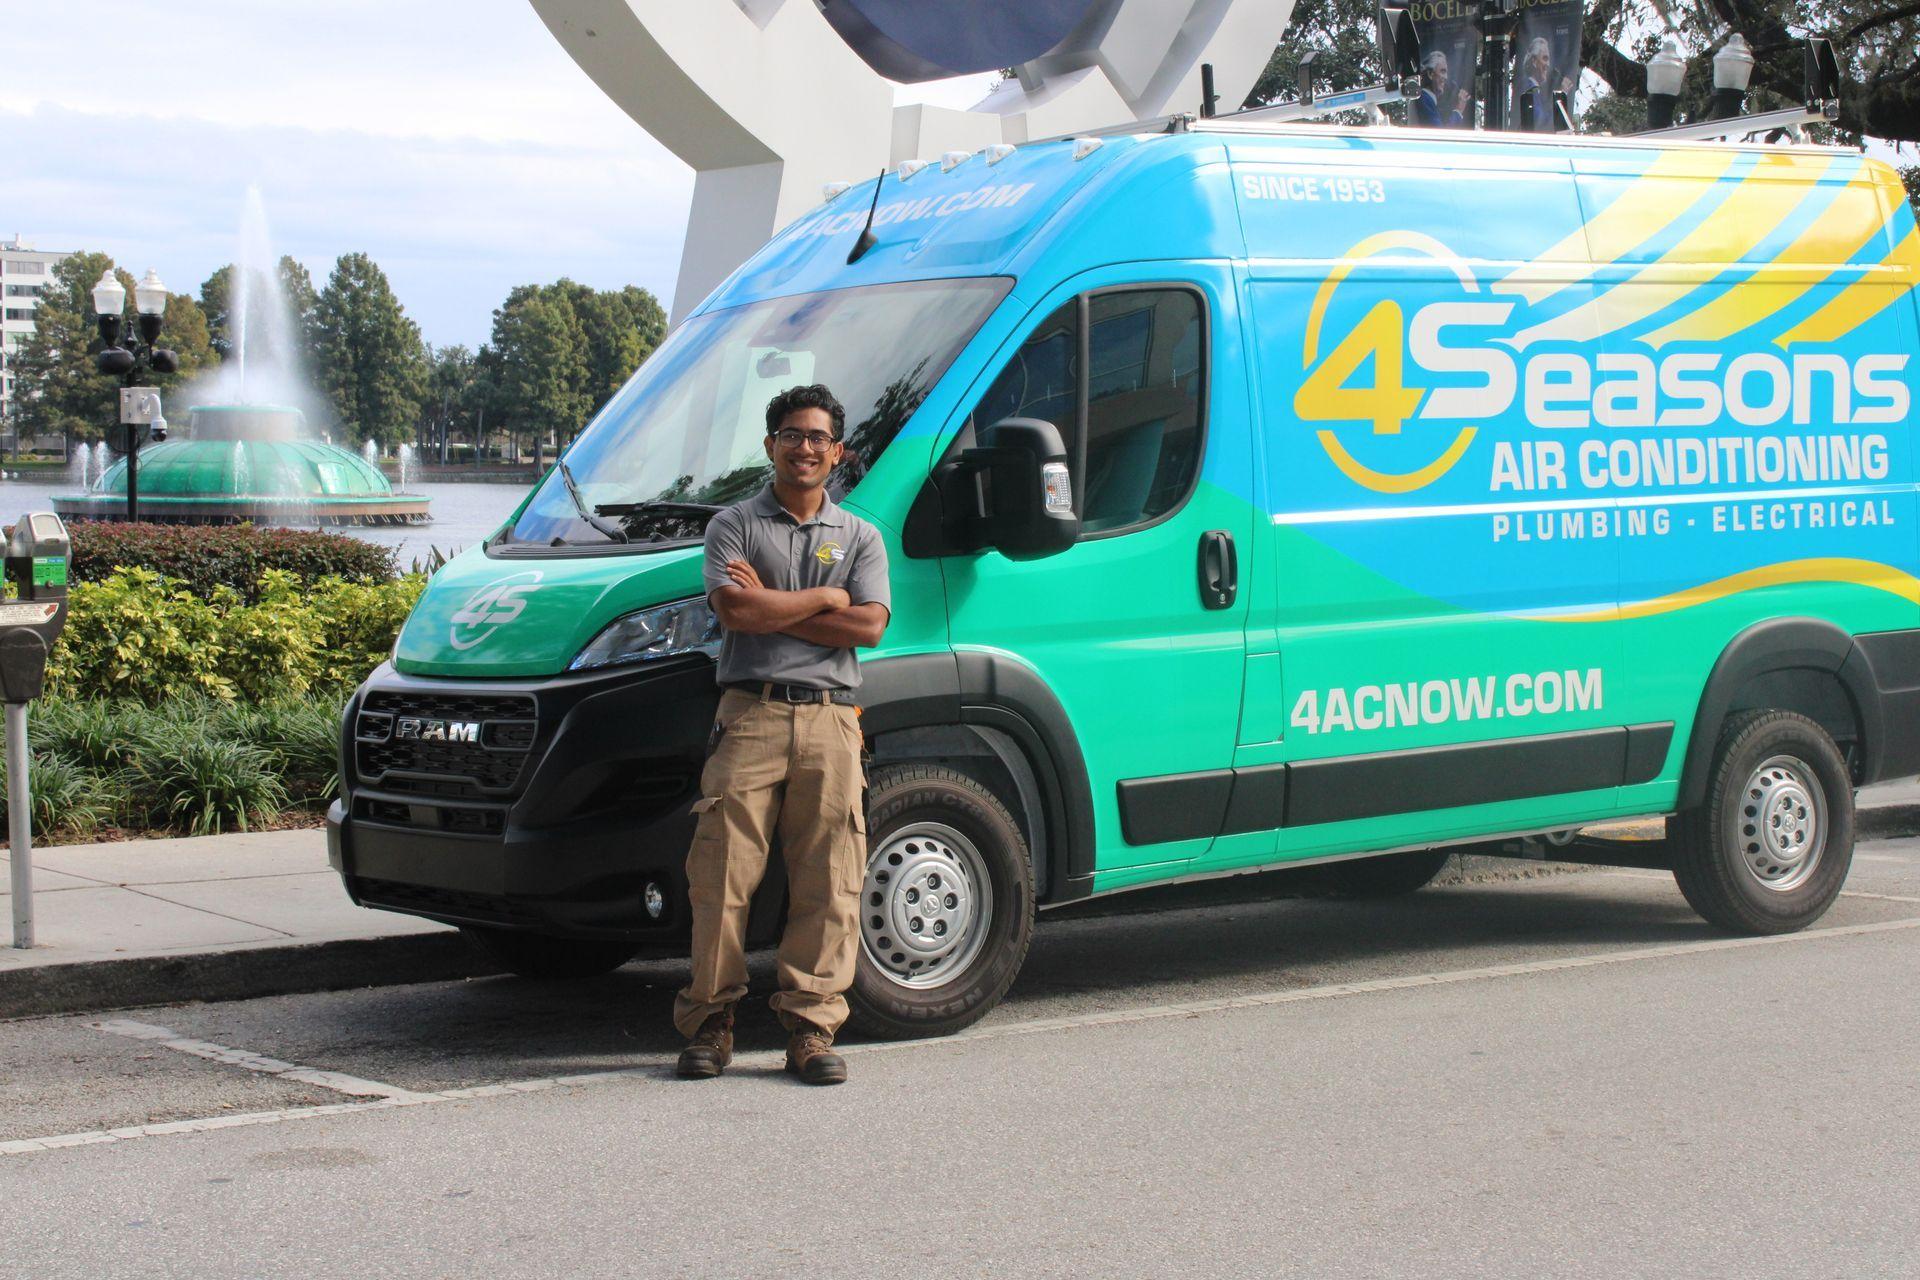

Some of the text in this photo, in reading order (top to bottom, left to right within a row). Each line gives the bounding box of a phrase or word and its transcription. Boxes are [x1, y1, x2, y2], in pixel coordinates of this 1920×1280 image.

[1243, 174, 1386, 203] SINCE 1953
[1489, 434, 1890, 491] AIR CONDITIONING
[1492, 509, 1670, 542] PLUMBING
[1713, 500, 1895, 533] ELECTRICAL
[450, 584, 544, 629] 4S
[1290, 668, 1603, 735] 4ACNOW.COM
[395, 719, 482, 743] RAM
[891, 988, 984, 1018] NEXEN
